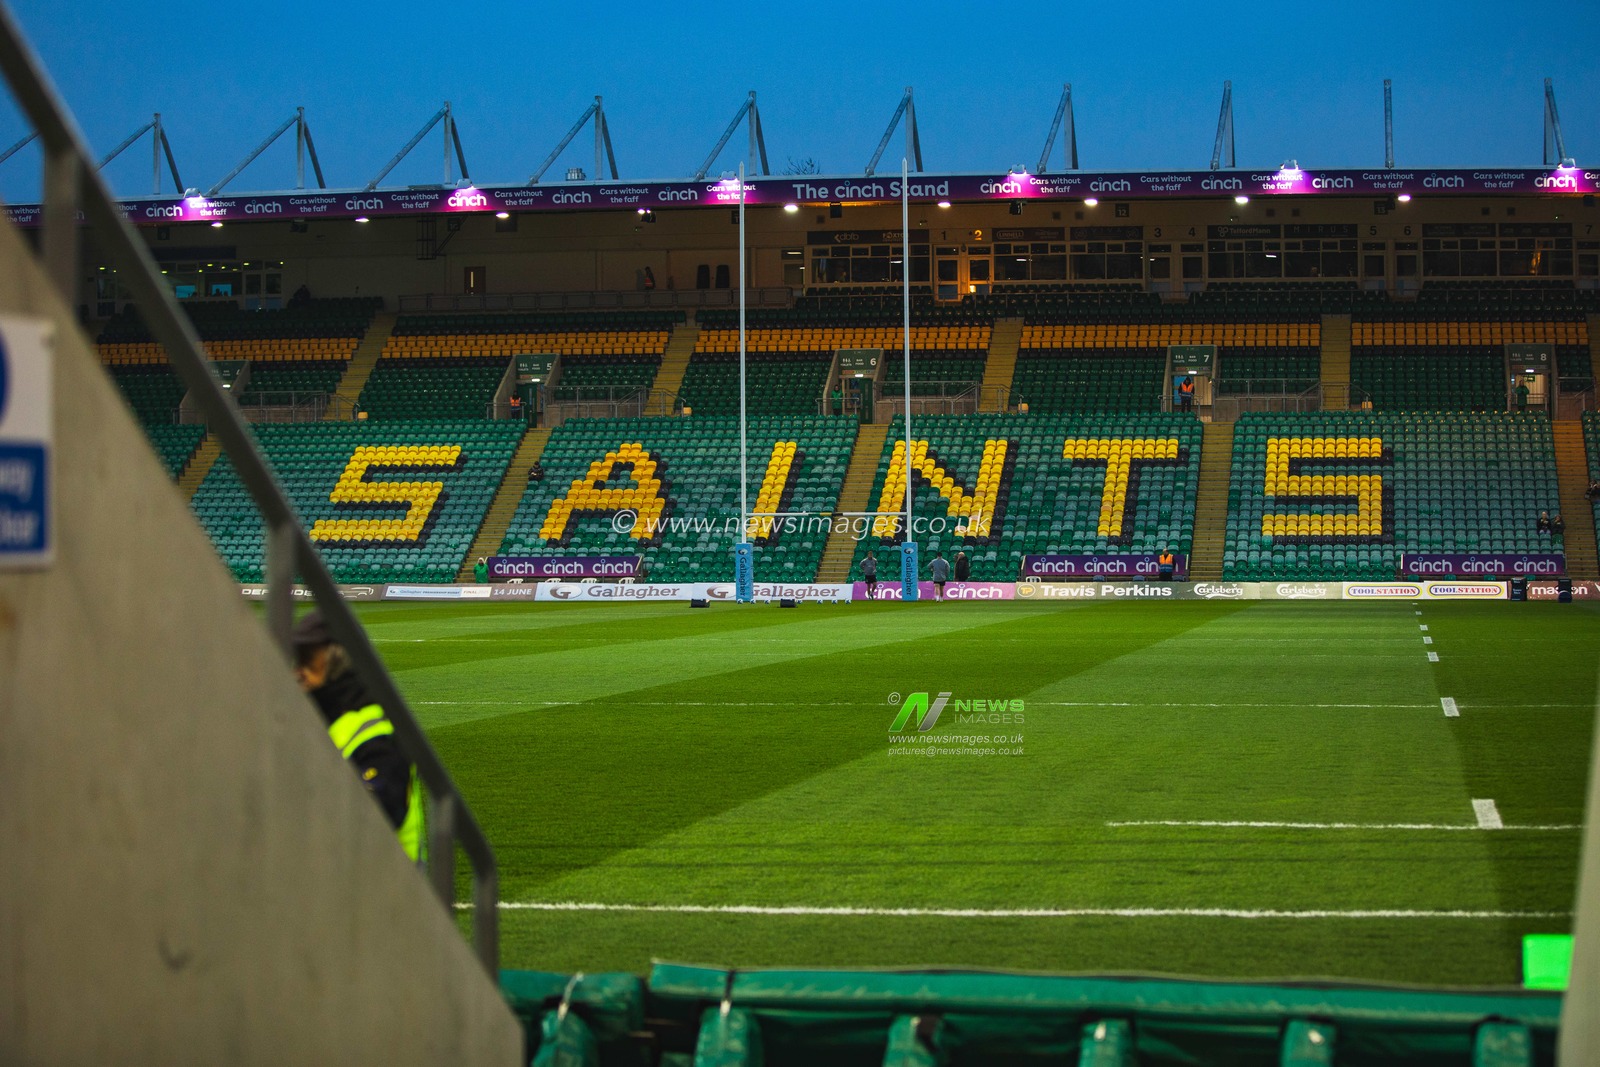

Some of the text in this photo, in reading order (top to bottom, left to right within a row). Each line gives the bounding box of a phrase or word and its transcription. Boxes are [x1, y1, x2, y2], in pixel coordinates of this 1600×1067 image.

[1160, 174, 1192, 182] without
[1251, 173, 1302, 182] Cars without
[1312, 174, 1354, 188] cinch
[1383, 172, 1414, 180] without
[1422, 173, 1464, 188] cinch
[1473, 172, 1524, 180] Cars without
[1534, 173, 1576, 188] cinch
[980, 178, 1022, 194] cinch
[1090, 176, 1130, 192] cinch
[1201, 174, 1242, 190] cinch
[1276, 182, 1292, 190] faff
[1498, 180, 1514, 188] faff
[513, 190, 542, 198] without
[658, 186, 698, 202] cinch
[792, 184, 829, 199] The
[834, 180, 884, 198] cinch
[1055, 185, 1070, 193] faff
[308, 196, 336, 204] without
[448, 192, 487, 208] cinch
[552, 189, 592, 204] cinch
[716, 192, 746, 200] the faf
[244, 200, 282, 214] cinch
[345, 196, 383, 210] cinch
[505, 198, 534, 206] the faff
[146, 203, 183, 217] cinch
[1154, 228, 1162, 237] 3
[1188, 228, 1196, 237] 4
[1370, 226, 1377, 236] 5
[1404, 226, 1411, 236] 6
[1586, 225, 1592, 234] 7
[942, 232, 946, 240] 1
[974, 230, 982, 240] 2
[546, 362, 552, 370] 5
[870, 358, 876, 366] 6
[494, 558, 634, 574] cinch cinch cinch
[1032, 557, 1178, 572] cinch cinch cin
[1409, 557, 1556, 572] cinch cinch cinch
[738, 556, 747, 596] Gallagher
[242, 588, 316, 596] DEFDE
[506, 588, 532, 596] JUNE
[588, 586, 680, 599] Gallagher
[946, 584, 1002, 599] cinch
[1041, 584, 1096, 596] Travis
[1102, 584, 1172, 596] Perkins
[1194, 584, 1243, 598] Carlsberg
[1276, 584, 1326, 598] Carlsberg
[1350, 587, 1417, 596] TOOLSTATION
[1432, 586, 1498, 594] TOOLSTATION
